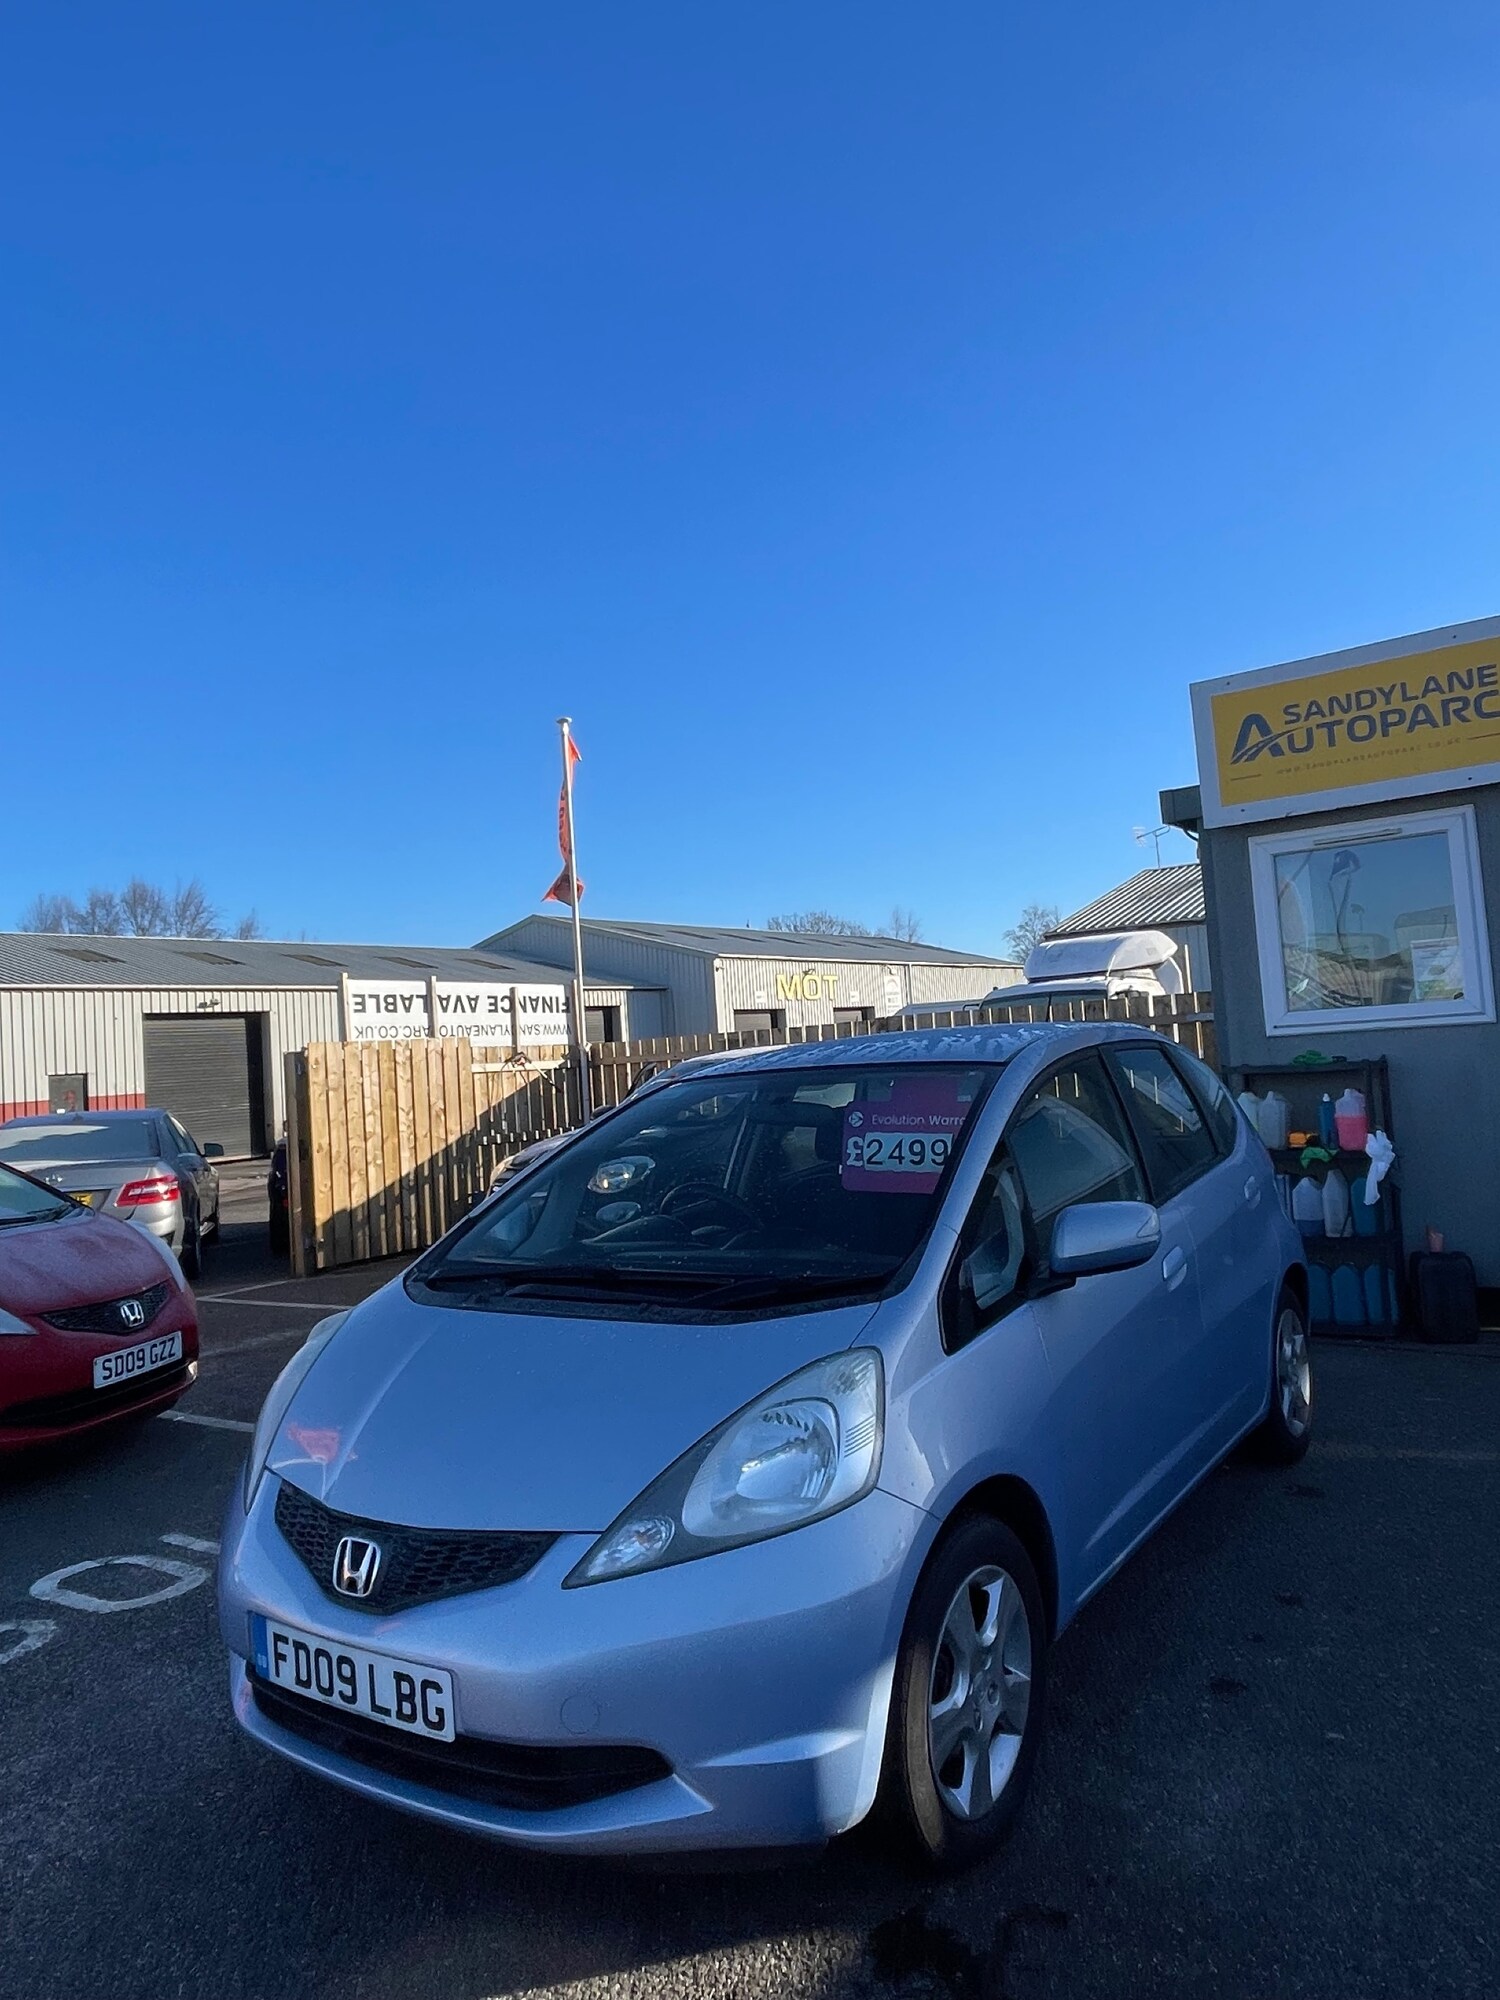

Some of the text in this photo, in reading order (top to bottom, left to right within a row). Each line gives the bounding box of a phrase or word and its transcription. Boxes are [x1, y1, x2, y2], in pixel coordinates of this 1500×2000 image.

[1282, 664, 1498, 725] SANDYLANE
[1230, 689, 1500, 765] AUTOPARC
[352, 994, 480, 1014] AVALABLE
[776, 974, 839, 1002] MOT
[872, 1114, 925, 1126] Evolution
[846, 1136, 949, 1167] £2499
[102, 1336, 177, 1380] SD09 GZZ
[272, 1632, 445, 1732] FD09 LBG
